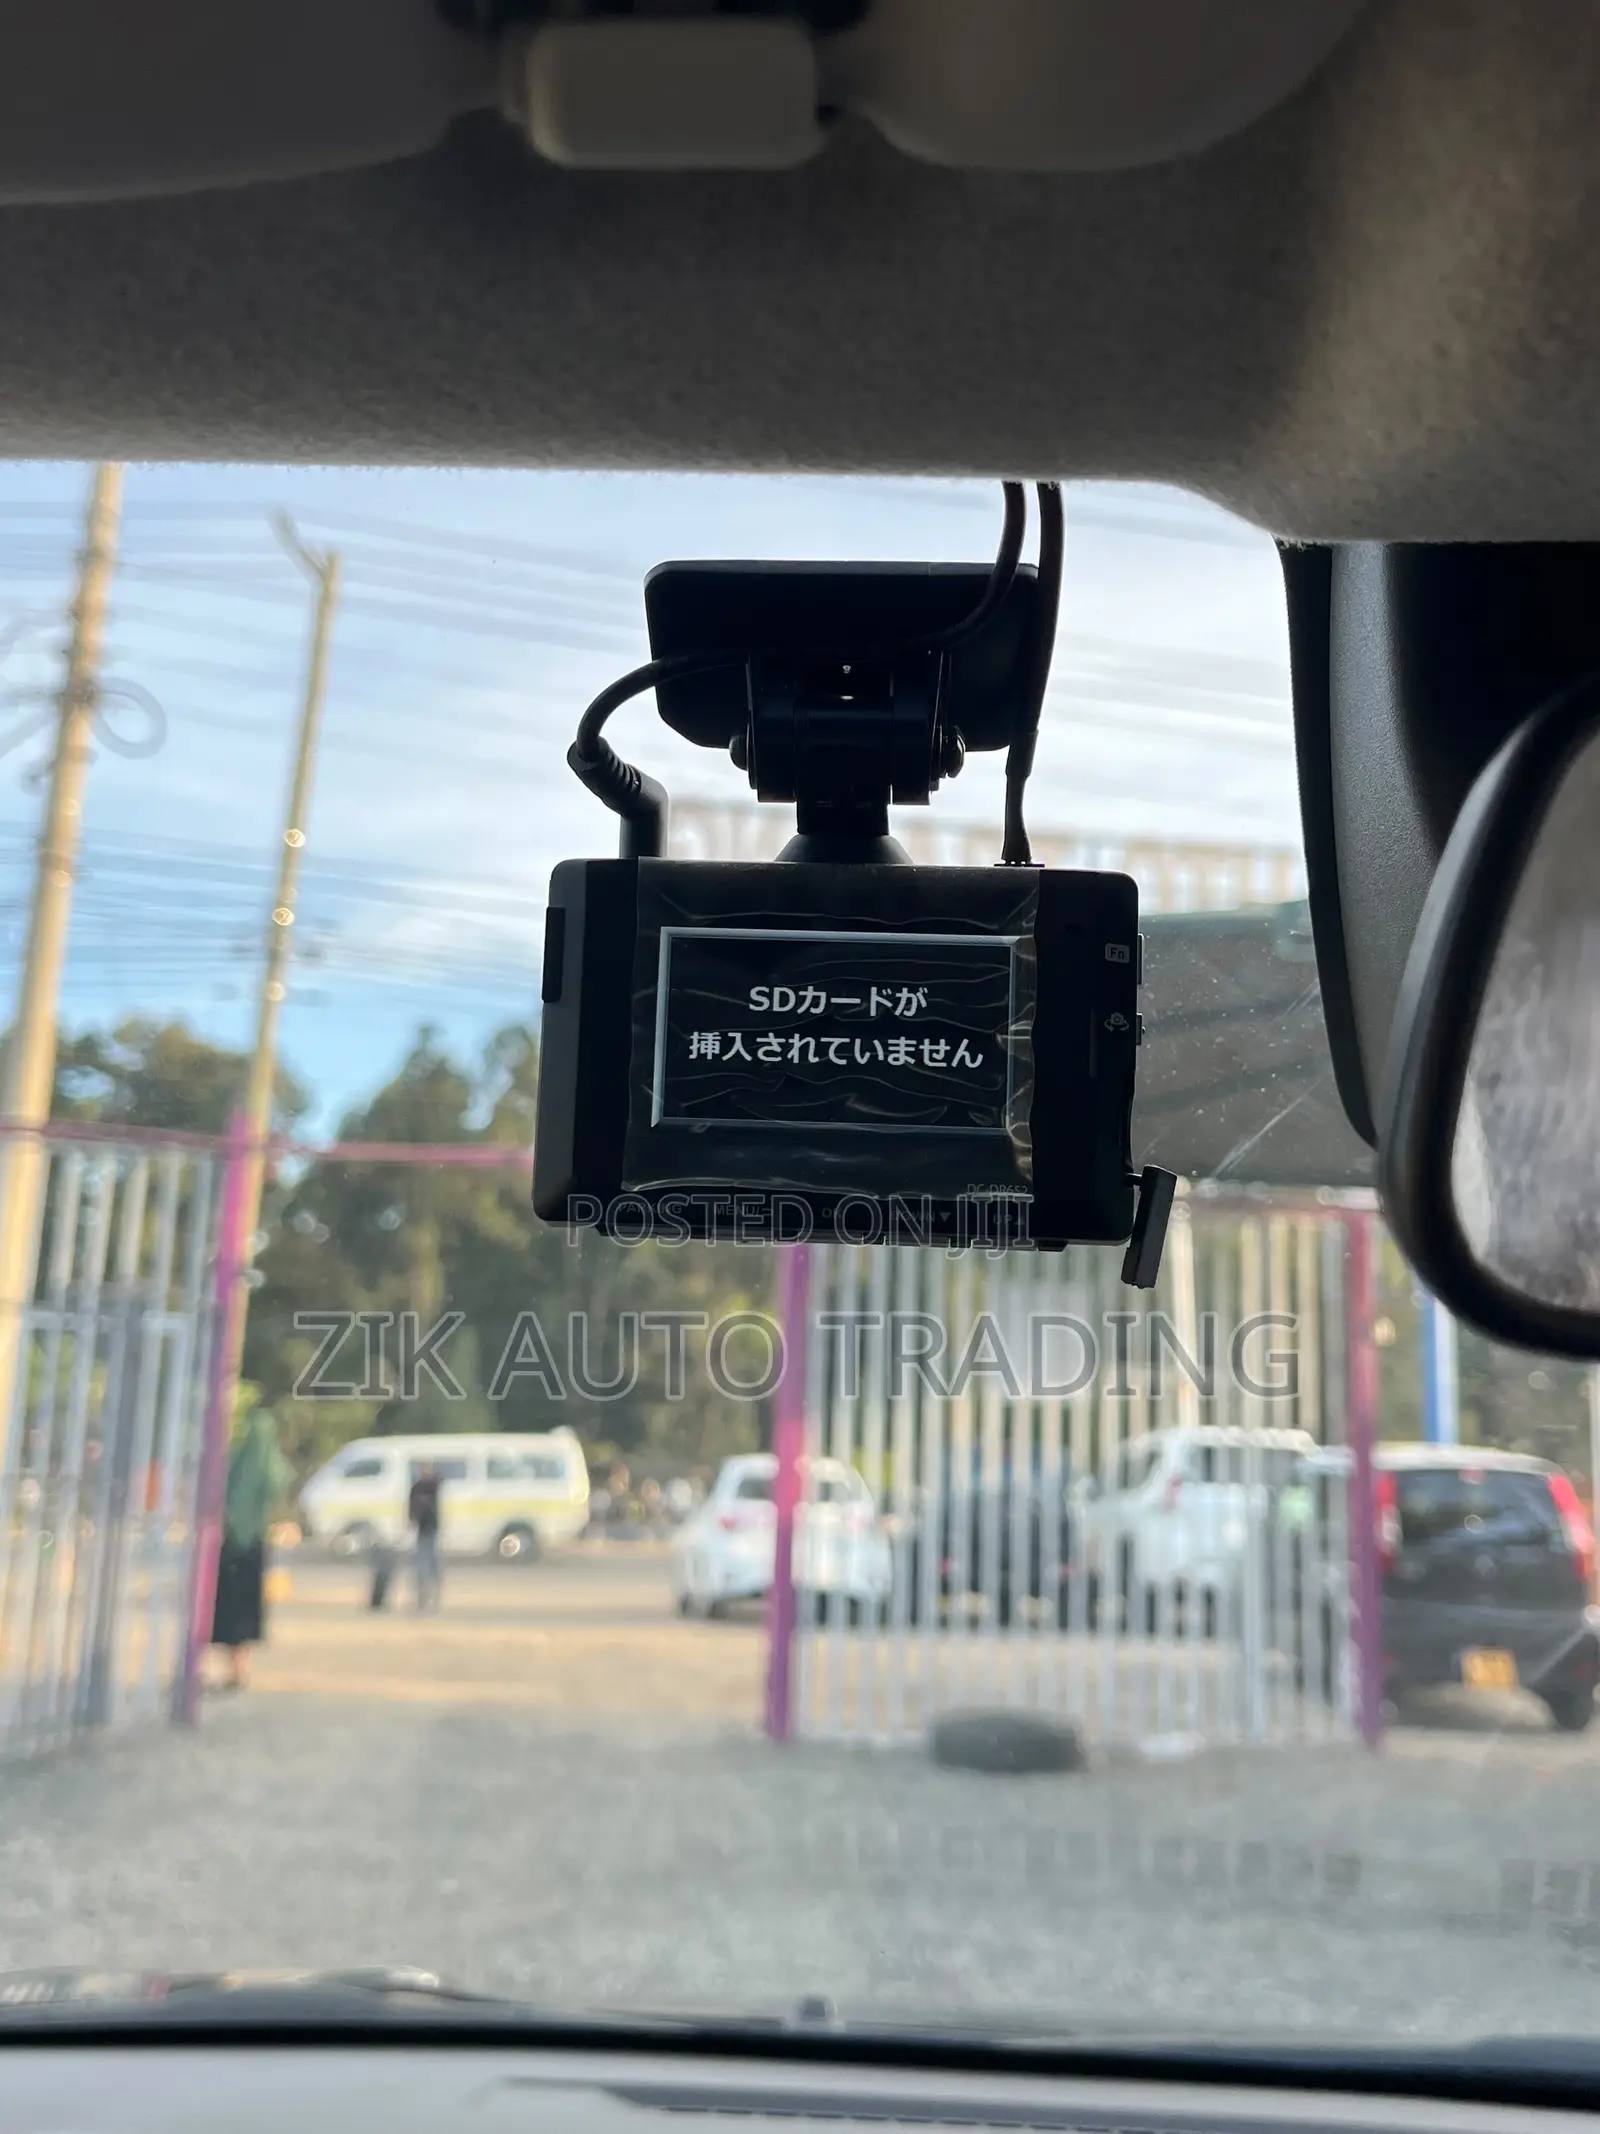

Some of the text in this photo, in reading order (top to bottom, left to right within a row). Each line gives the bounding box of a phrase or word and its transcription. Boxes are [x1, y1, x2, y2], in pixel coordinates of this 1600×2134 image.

[1109, 947, 1125, 960] Fn
[748, 985, 929, 1017] SDカードが
[688, 1031, 984, 1069] 挿入されていません
